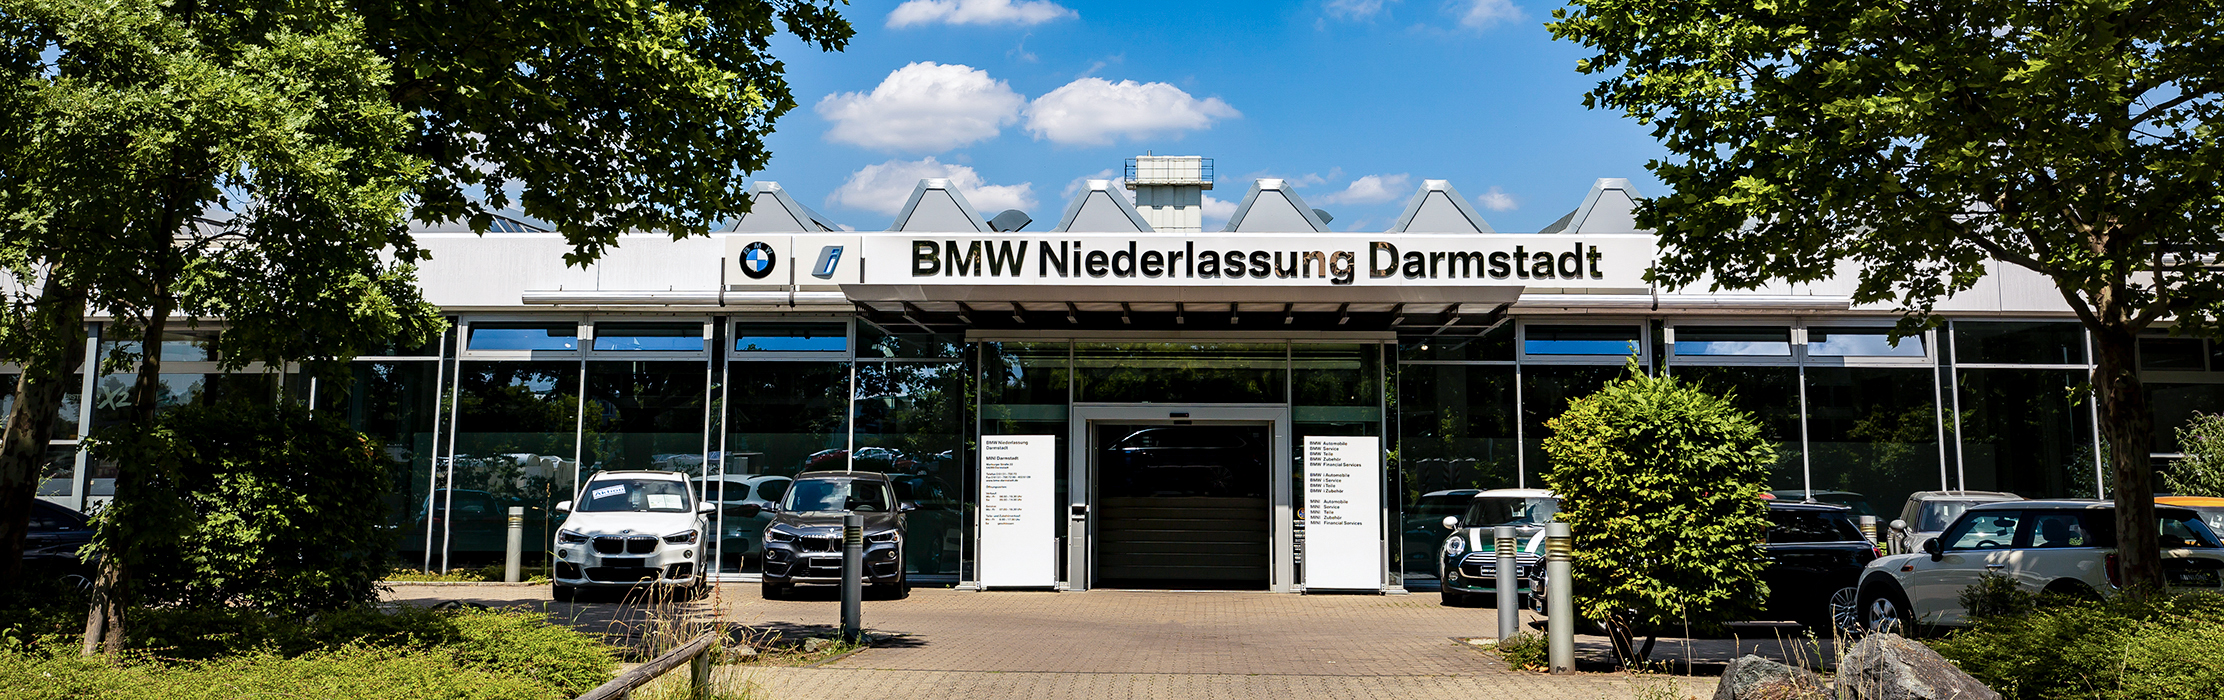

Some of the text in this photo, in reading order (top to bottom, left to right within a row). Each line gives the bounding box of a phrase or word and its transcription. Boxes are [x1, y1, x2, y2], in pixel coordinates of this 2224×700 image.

[743, 242, 773, 254] BMW
[911, 239, 1603, 285] BMW Niederlassung Darmstadt
[97, 385, 132, 411] X2
[595, 487, 624, 496] Aktion
